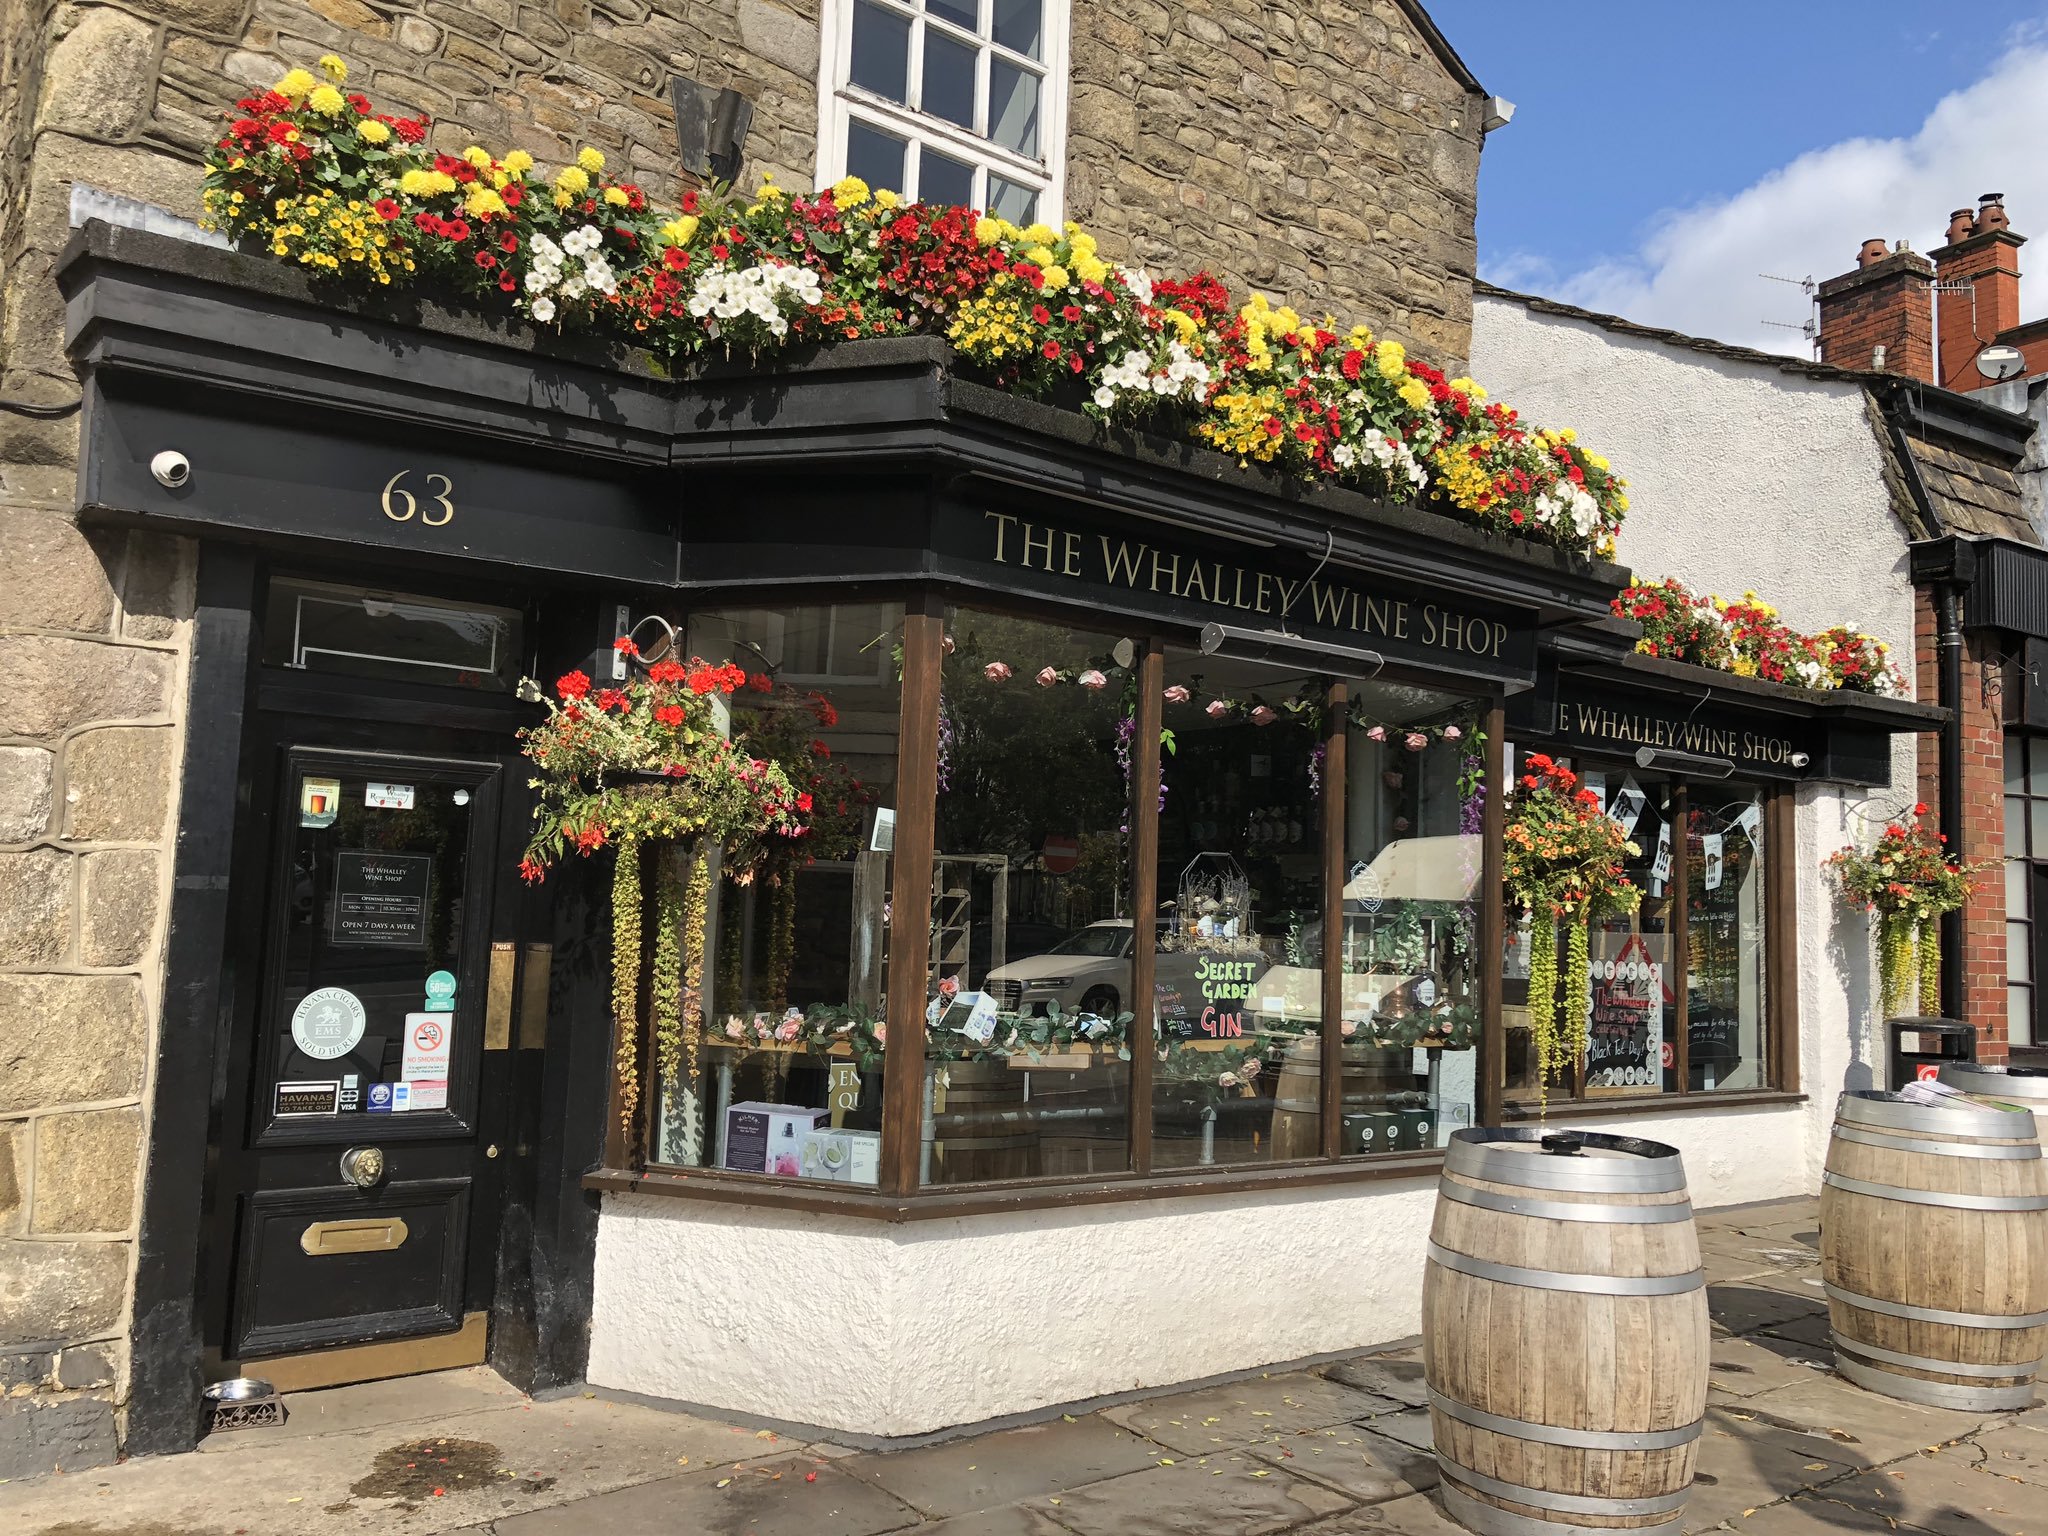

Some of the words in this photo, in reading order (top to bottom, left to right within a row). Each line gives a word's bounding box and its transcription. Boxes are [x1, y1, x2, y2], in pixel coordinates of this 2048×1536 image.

[382, 469, 454, 526] 63
[984, 510, 1082, 577] THE
[1099, 535, 1299, 618] WHALLEY
[1310, 581, 1409, 639] WINE
[1423, 605, 1508, 658] SHOP
[1576, 703, 1678, 747] WHALLEY
[1682, 721, 1737, 757] WINE
[1743, 731, 1792, 763] SHOP
[376, 867, 407, 876] WHALLEY
[1194, 955, 1256, 981] SECRET
[1155, 984, 1166, 992] The
[1202, 980, 1257, 1004] GARDEN
[1595, 987, 1611, 1006] The
[1612, 995, 1646, 1009] Whalley
[297, 992, 331, 1019] HAVANA
[333, 992, 361, 1018] CIGARS
[315, 1027, 341, 1035] EMS
[1201, 1006, 1242, 1037] GIN
[1595, 1008, 1615, 1021] Wine
[1618, 1010, 1639, 1031] Shop
[301, 1037, 326, 1055] SOLD
[328, 1037, 356, 1055] HERE
[1591, 1039, 1611, 1061] Black
[1614, 1039, 1625, 1056] Tot
[1628, 1041, 1645, 1062] Day!
[280, 1094, 333, 1102] HAVANAS
